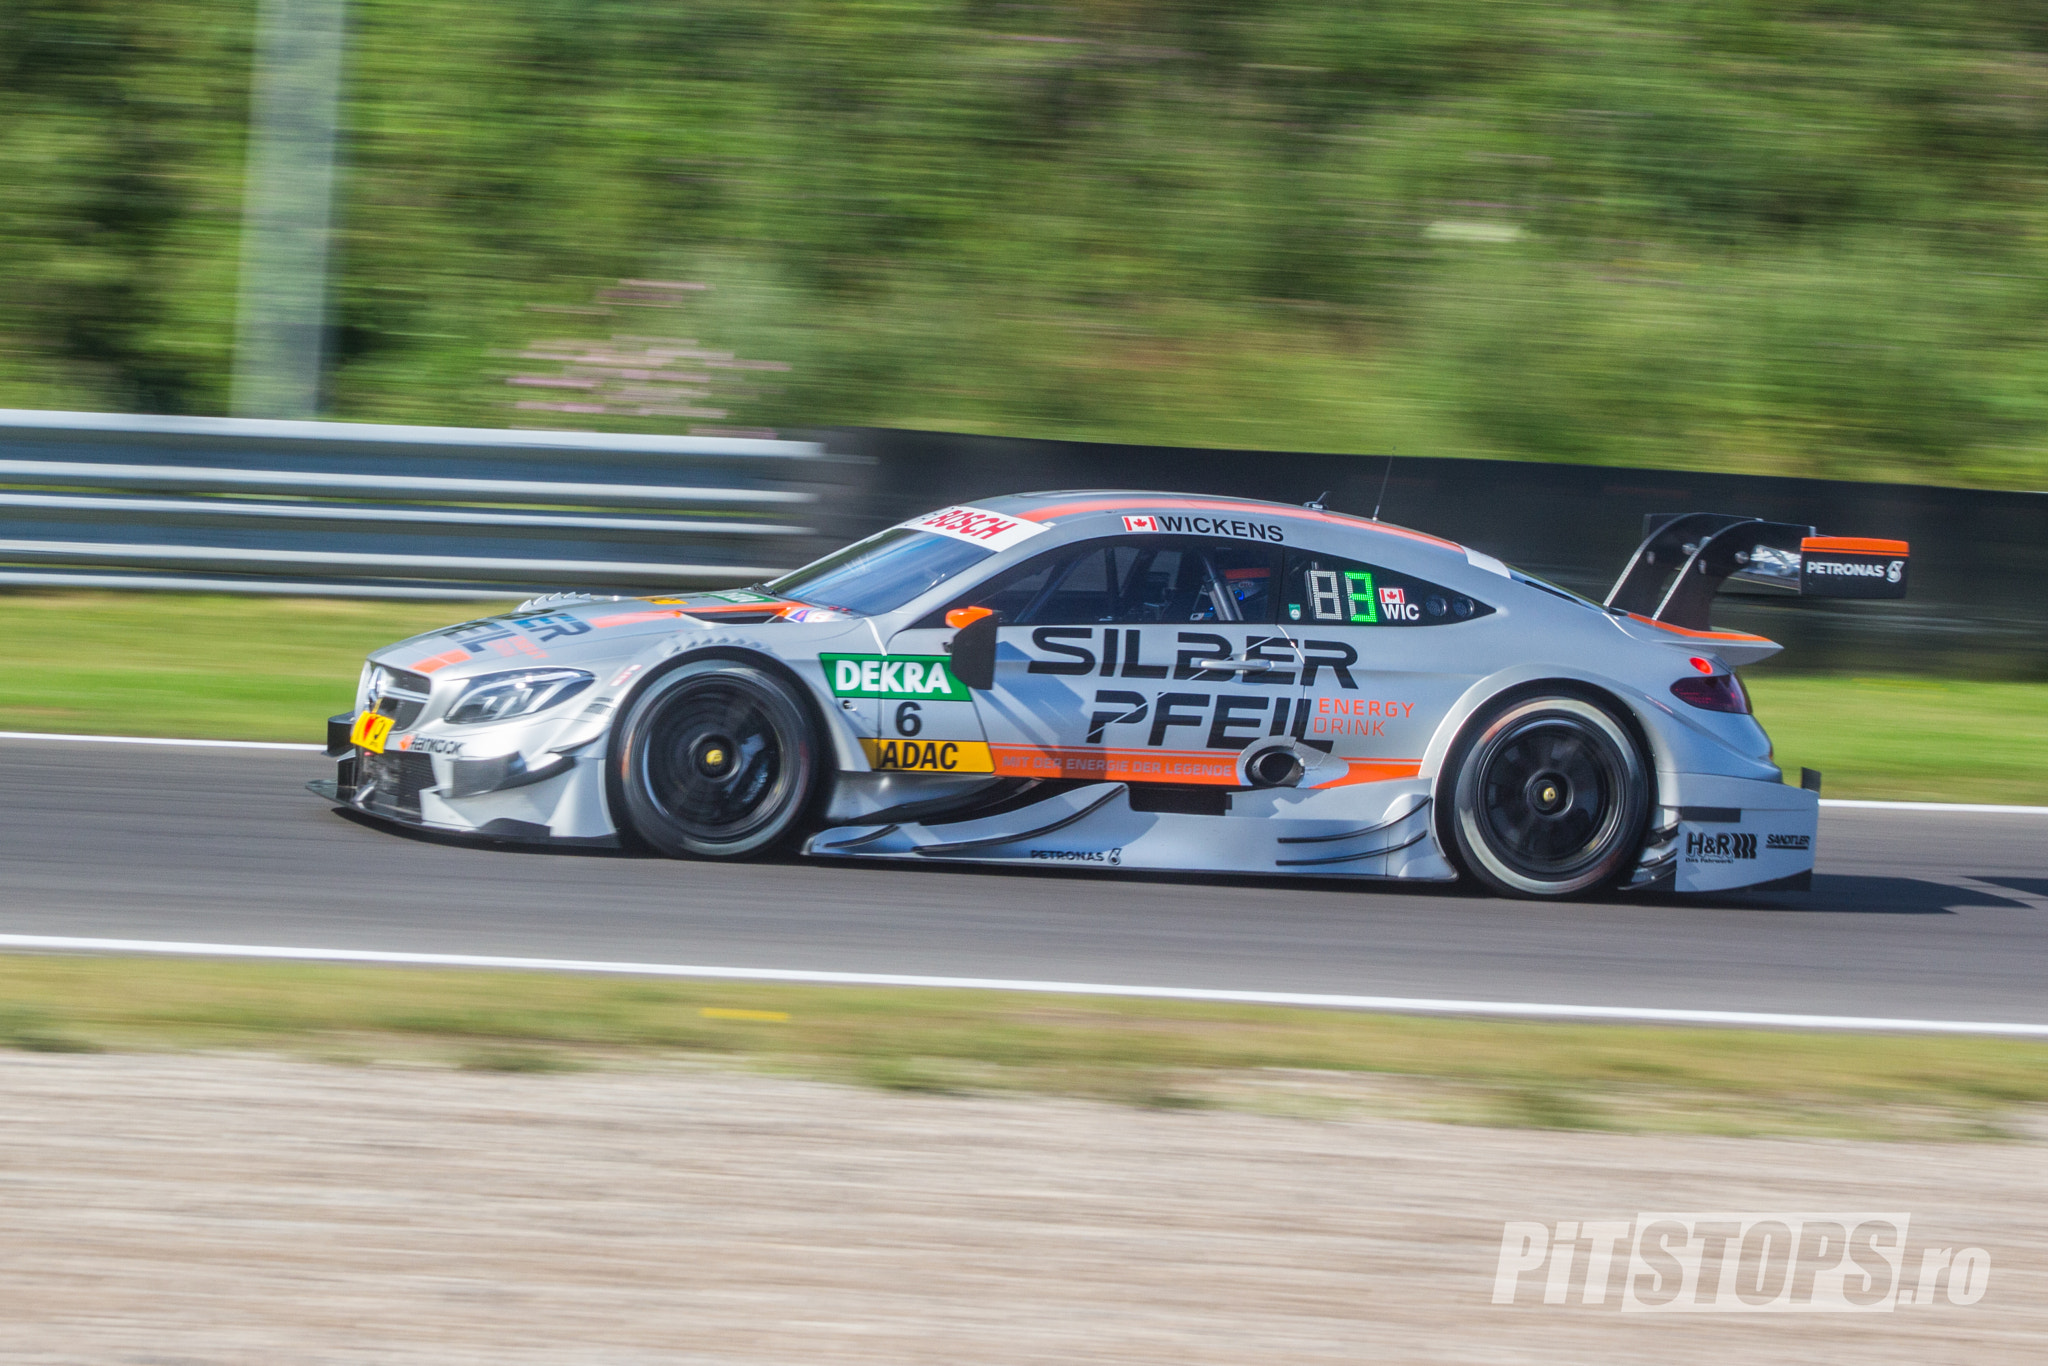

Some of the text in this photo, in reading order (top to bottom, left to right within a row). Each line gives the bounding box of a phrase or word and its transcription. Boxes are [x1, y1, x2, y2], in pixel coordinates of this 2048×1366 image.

[923, 510, 1018, 540] BOSCH
[1159, 516, 1284, 542] WICKENS
[1806, 561, 1885, 578] PETRONAS
[1382, 604, 1420, 620] WIC
[1027, 627, 1358, 690] SILBER
[835, 660, 952, 694] DEKRA
[895, 701, 922, 737] 6
[1319, 697, 1415, 718] ENERGY
[1086, 689, 1334, 754] PFEIL
[1313, 717, 1385, 737] DRINK
[881, 741, 958, 770] ADAC
[1002, 755, 1232, 777] MIT DER ENERGIE DER LEGENDE
[1031, 850, 1104, 861] PETRONAS
[1686, 832, 1733, 856] H&R
